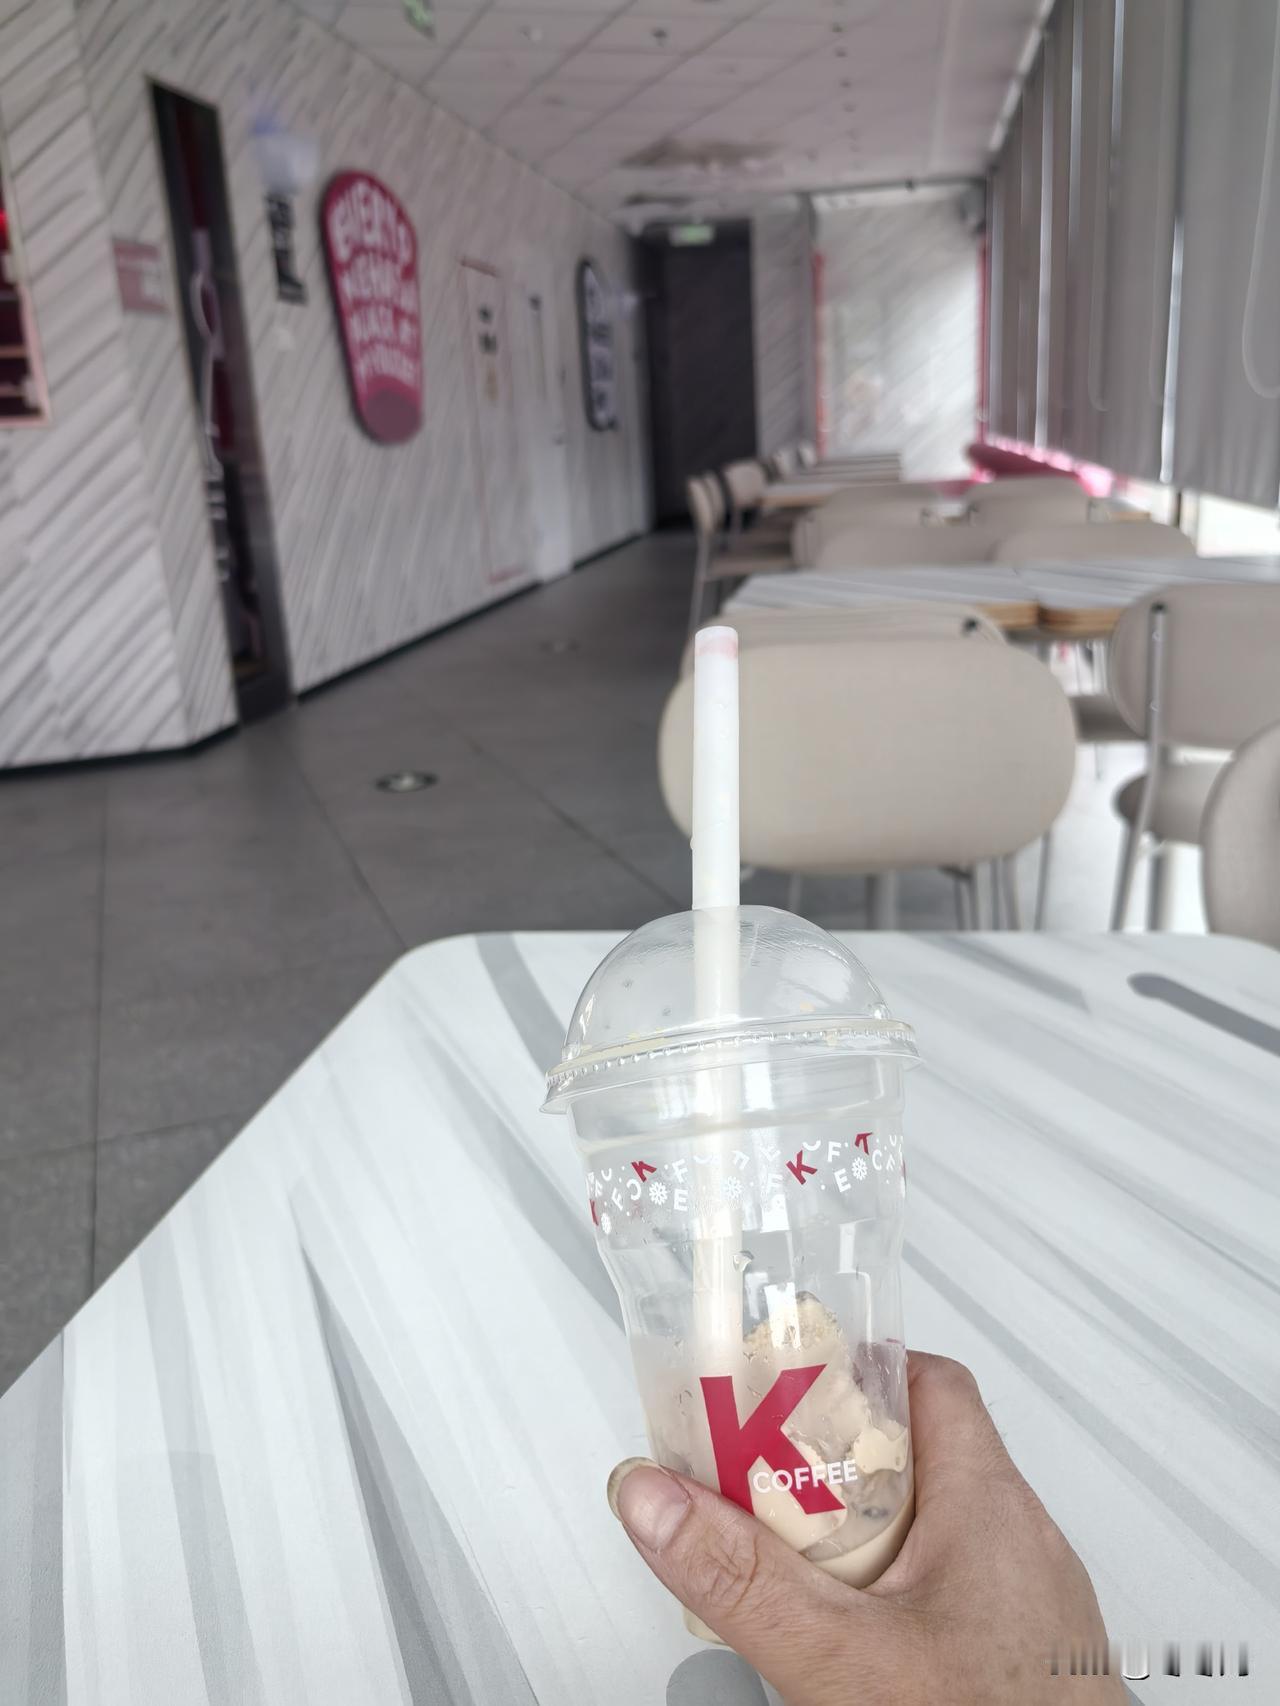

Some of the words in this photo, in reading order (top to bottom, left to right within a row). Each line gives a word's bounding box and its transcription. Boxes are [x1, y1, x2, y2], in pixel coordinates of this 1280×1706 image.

[785, 1149, 818, 1185] K
[700, 1363, 846, 1517] K
[752, 1459, 858, 1493] COFFEE
